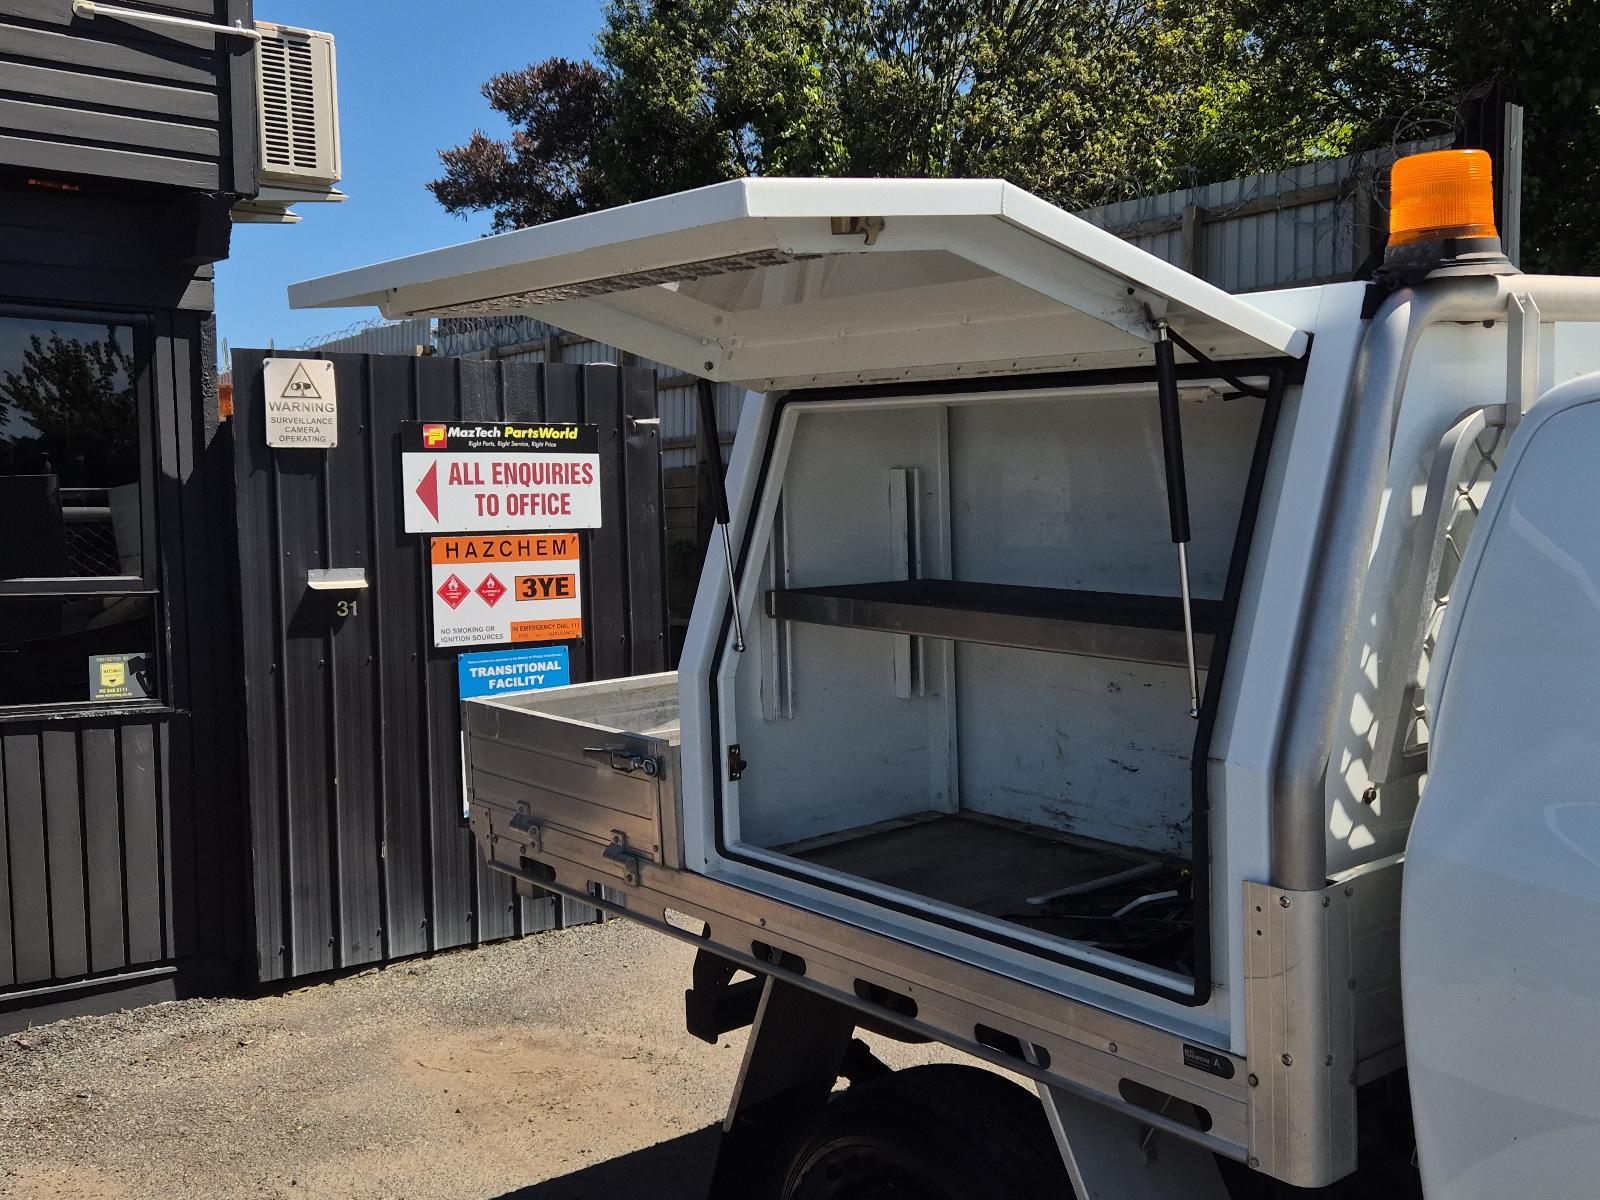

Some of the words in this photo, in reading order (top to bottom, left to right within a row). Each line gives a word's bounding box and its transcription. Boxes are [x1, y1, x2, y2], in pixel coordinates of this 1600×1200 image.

[269, 401, 334, 413] WARNING
[270, 416, 333, 424] SURVEILLANCE
[284, 426, 320, 434] CAMERA
[448, 426, 501, 439] MazTech
[504, 427, 578, 440] PartsWorld
[278, 435, 326, 443] OPERATING
[468, 440, 481, 448] Right
[497, 440, 510, 448] Right
[531, 441, 544, 449] Right
[448, 462, 485, 486] ALL
[492, 462, 594, 487] ENQUIRIES
[475, 493, 500, 516] TO
[506, 492, 571, 516] OFFICE
[445, 539, 567, 559] HAZCHEM
[522, 576, 569, 598] 3YE
[336, 600, 358, 617] 31
[452, 626, 484, 634] SMOKING
[519, 623, 556, 632] EMERGENCY
[440, 635, 471, 643] IGNITION
[471, 633, 504, 641] SOURCES
[469, 660, 562, 678] TRANSITIONAL
[488, 674, 545, 689] FACILITY
